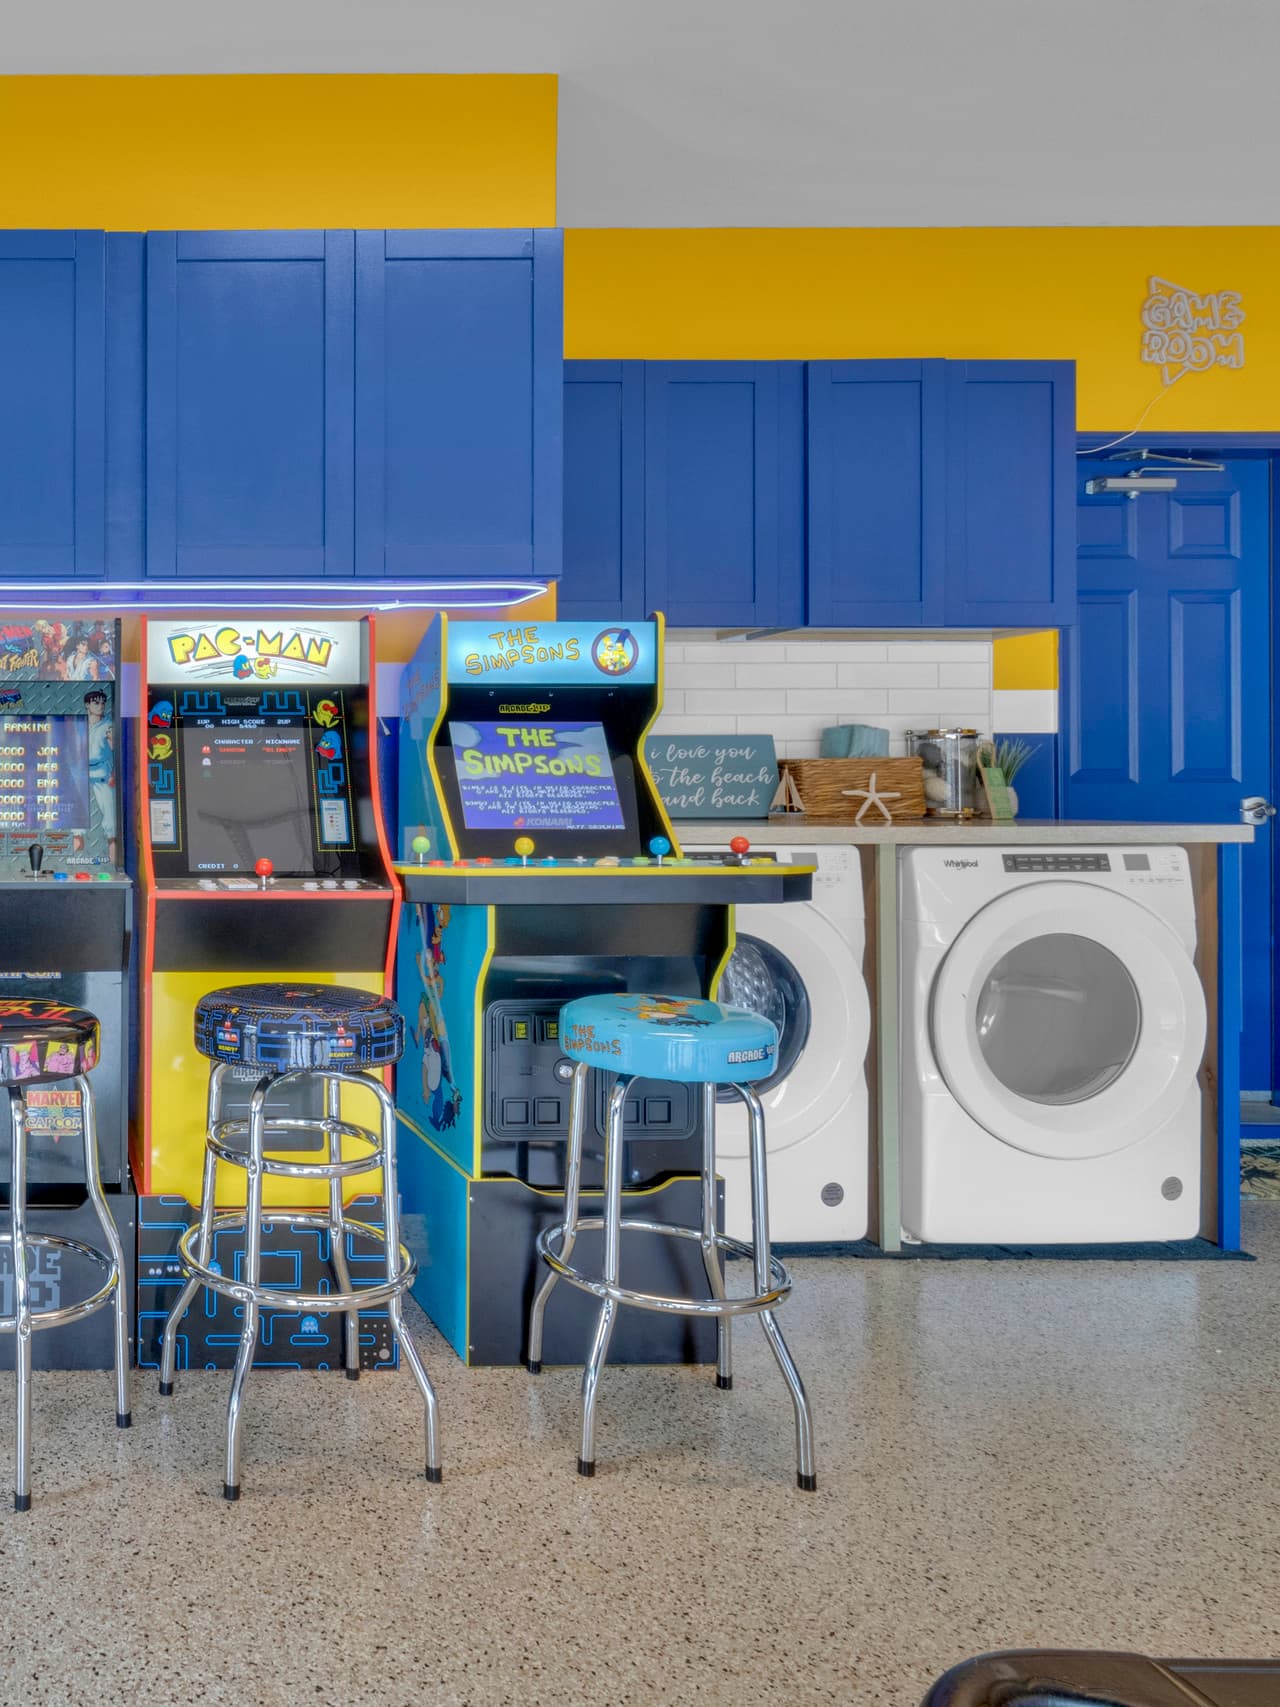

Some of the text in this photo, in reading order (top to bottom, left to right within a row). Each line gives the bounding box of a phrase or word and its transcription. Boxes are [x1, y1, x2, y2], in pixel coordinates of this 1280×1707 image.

[1142, 290, 1246, 331] GAME
[1142, 329, 1245, 370] ROOM
[167, 626, 333, 668] PAC-MAN
[488, 626, 538, 649] THE
[464, 638, 581, 676] SIMPSONS
[4, 723, 51, 733] RANKING
[496, 727, 556, 748] THE
[462, 749, 602, 777] SIMPSONS
[666, 744, 711, 762] love
[714, 746, 757, 765] you
[660, 766, 774, 787] the beach
[661, 787, 760, 808] and back
[526, 817, 573, 826] KONAMI
[943, 859, 979, 869] Whirlpool
[571, 1025, 595, 1038] THE
[564, 1035, 622, 1055] SIMPSONS
